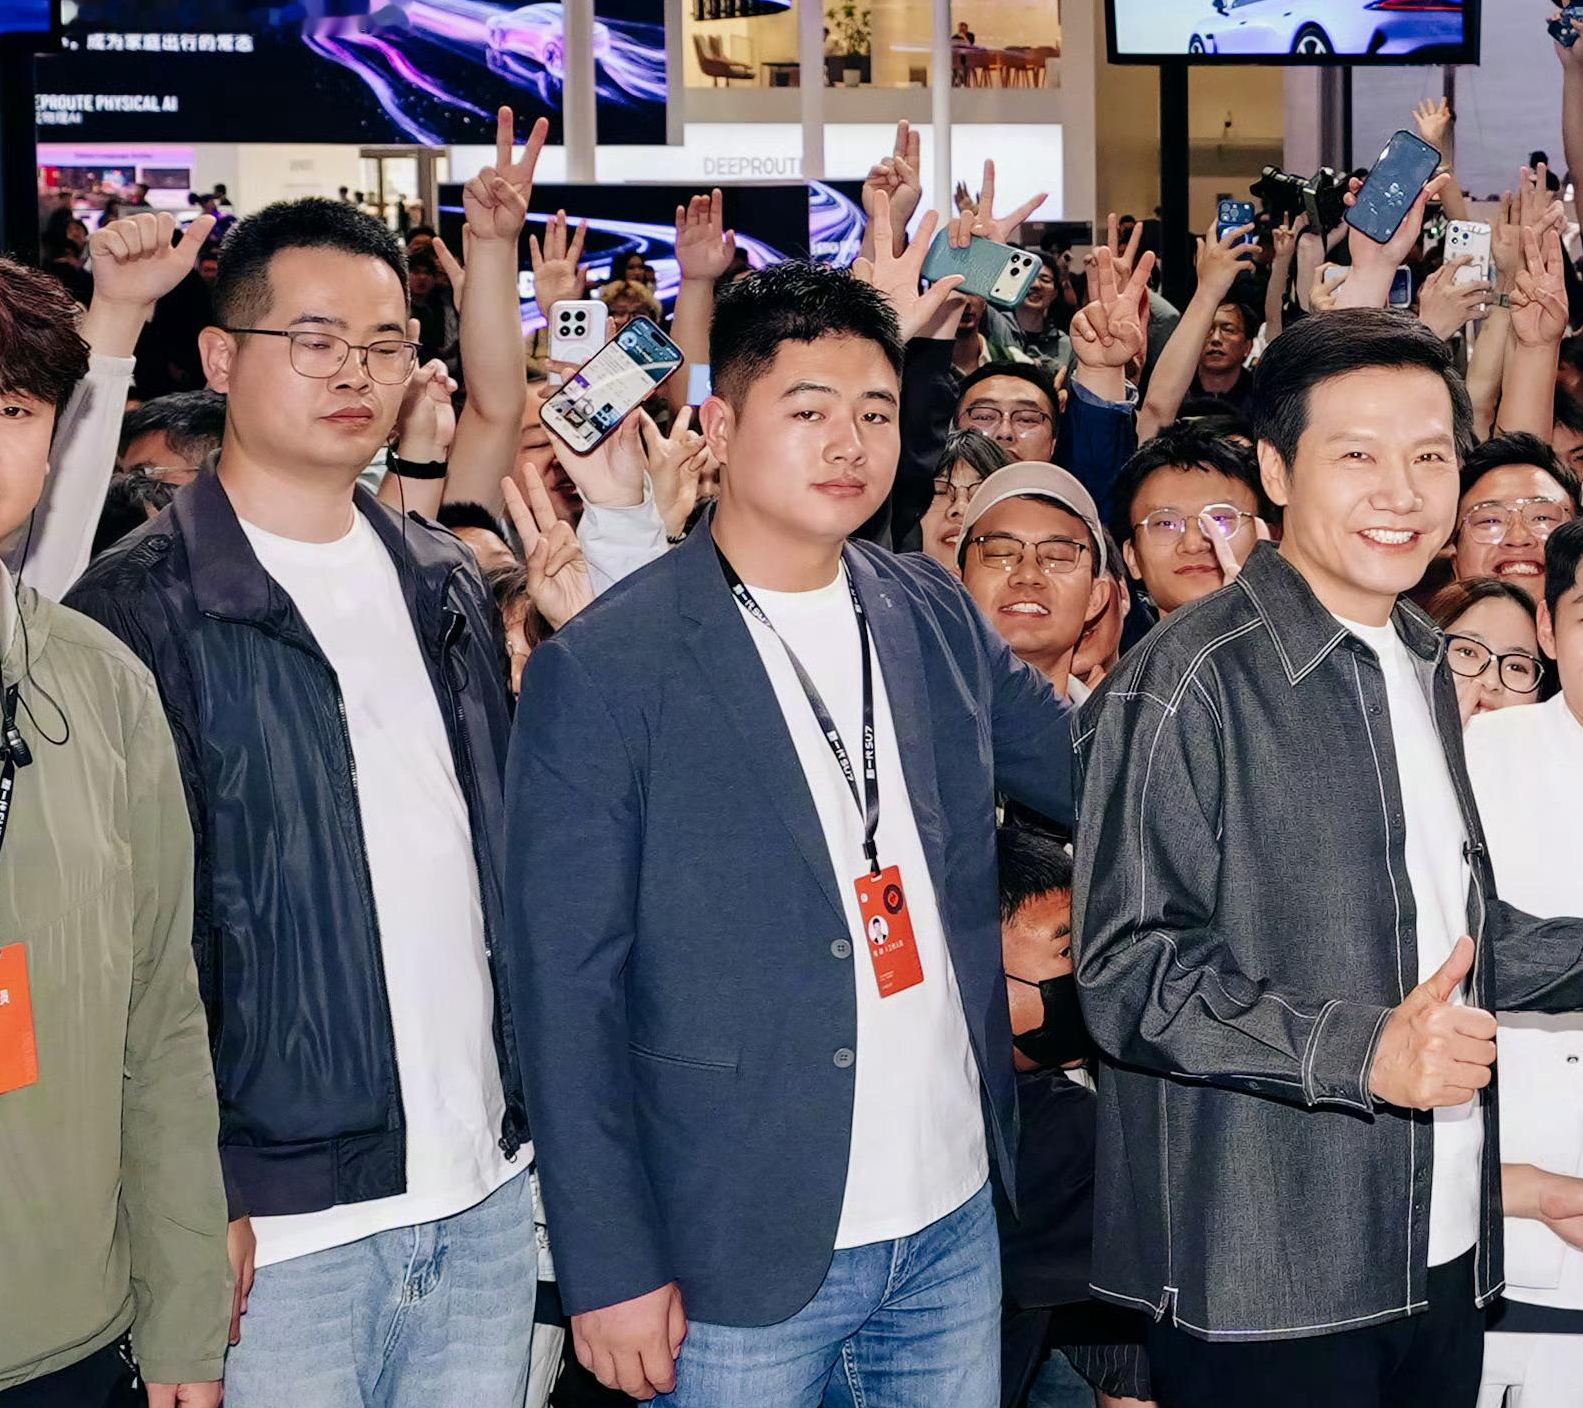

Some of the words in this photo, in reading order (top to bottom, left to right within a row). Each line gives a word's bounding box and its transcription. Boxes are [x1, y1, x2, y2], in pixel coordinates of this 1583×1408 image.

[95, 95, 159, 112] PHYSICAL
[161, 96, 178, 112] AI
[704, 156, 804, 175] DEEPROUT
